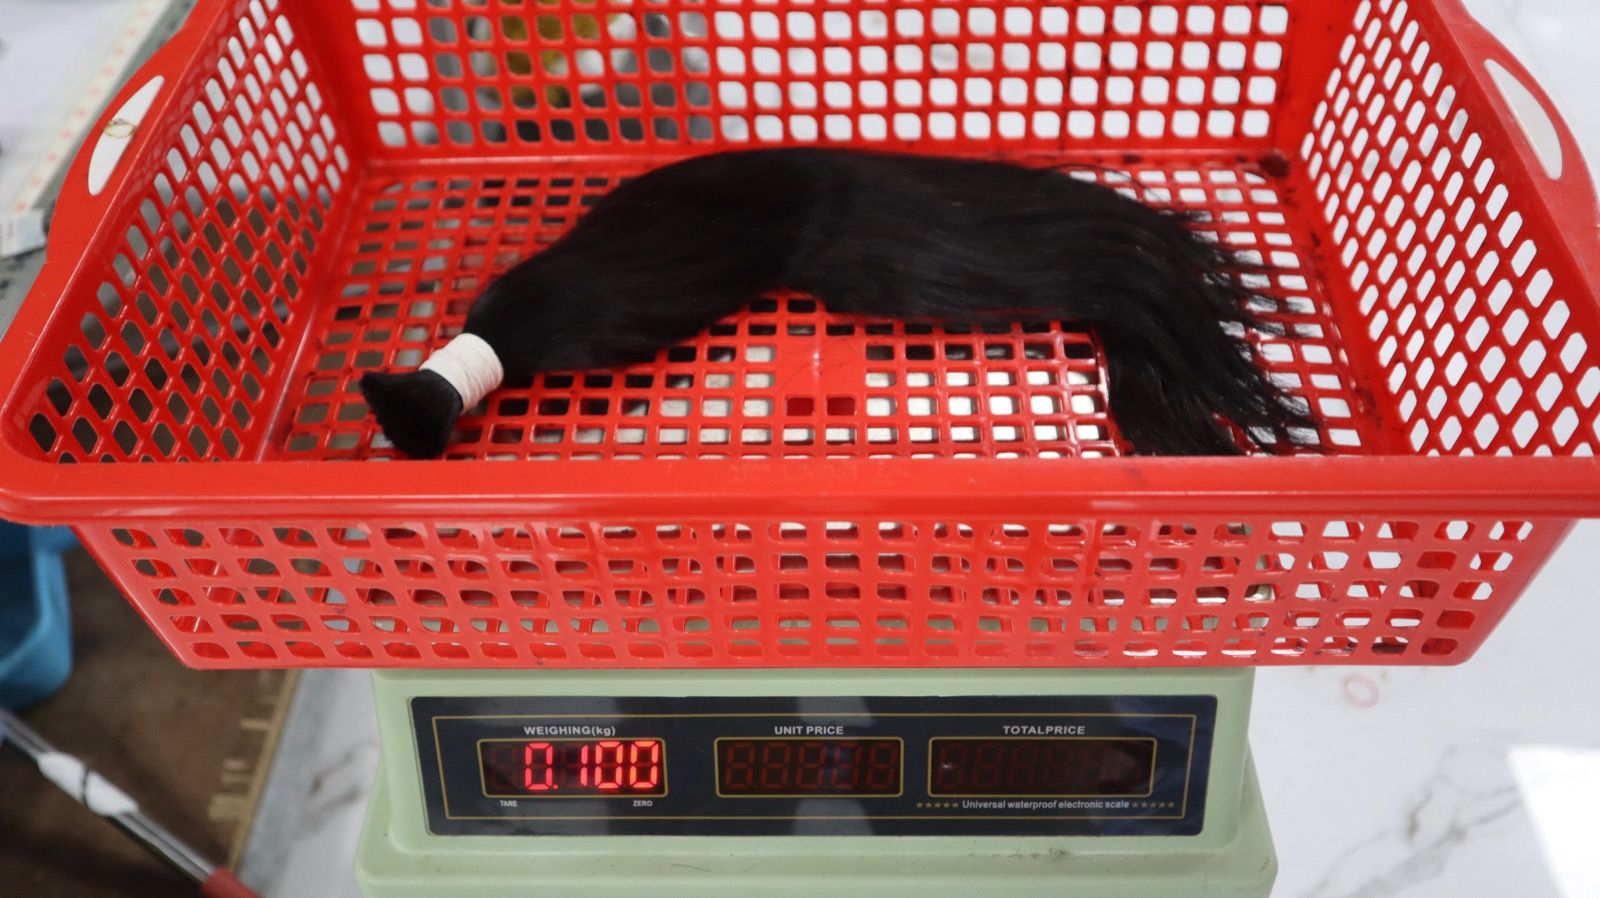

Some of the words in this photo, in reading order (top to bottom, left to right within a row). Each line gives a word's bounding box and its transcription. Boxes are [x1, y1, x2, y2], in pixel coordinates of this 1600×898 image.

[524, 726, 616, 736] WEIGHING(kg)
[774, 725, 804, 735] UNIT
[807, 725, 845, 735] PRICE
[1003, 725, 1086, 735] TOTALPRICE
[525, 741, 659, 790] 0.100
[632, 800, 653, 808] ZERO
[962, 798, 1006, 810] Universal
[1007, 798, 1057, 811] waterproof
[1058, 798, 1103, 810] electronic
[1104, 799, 1129, 809] scale
